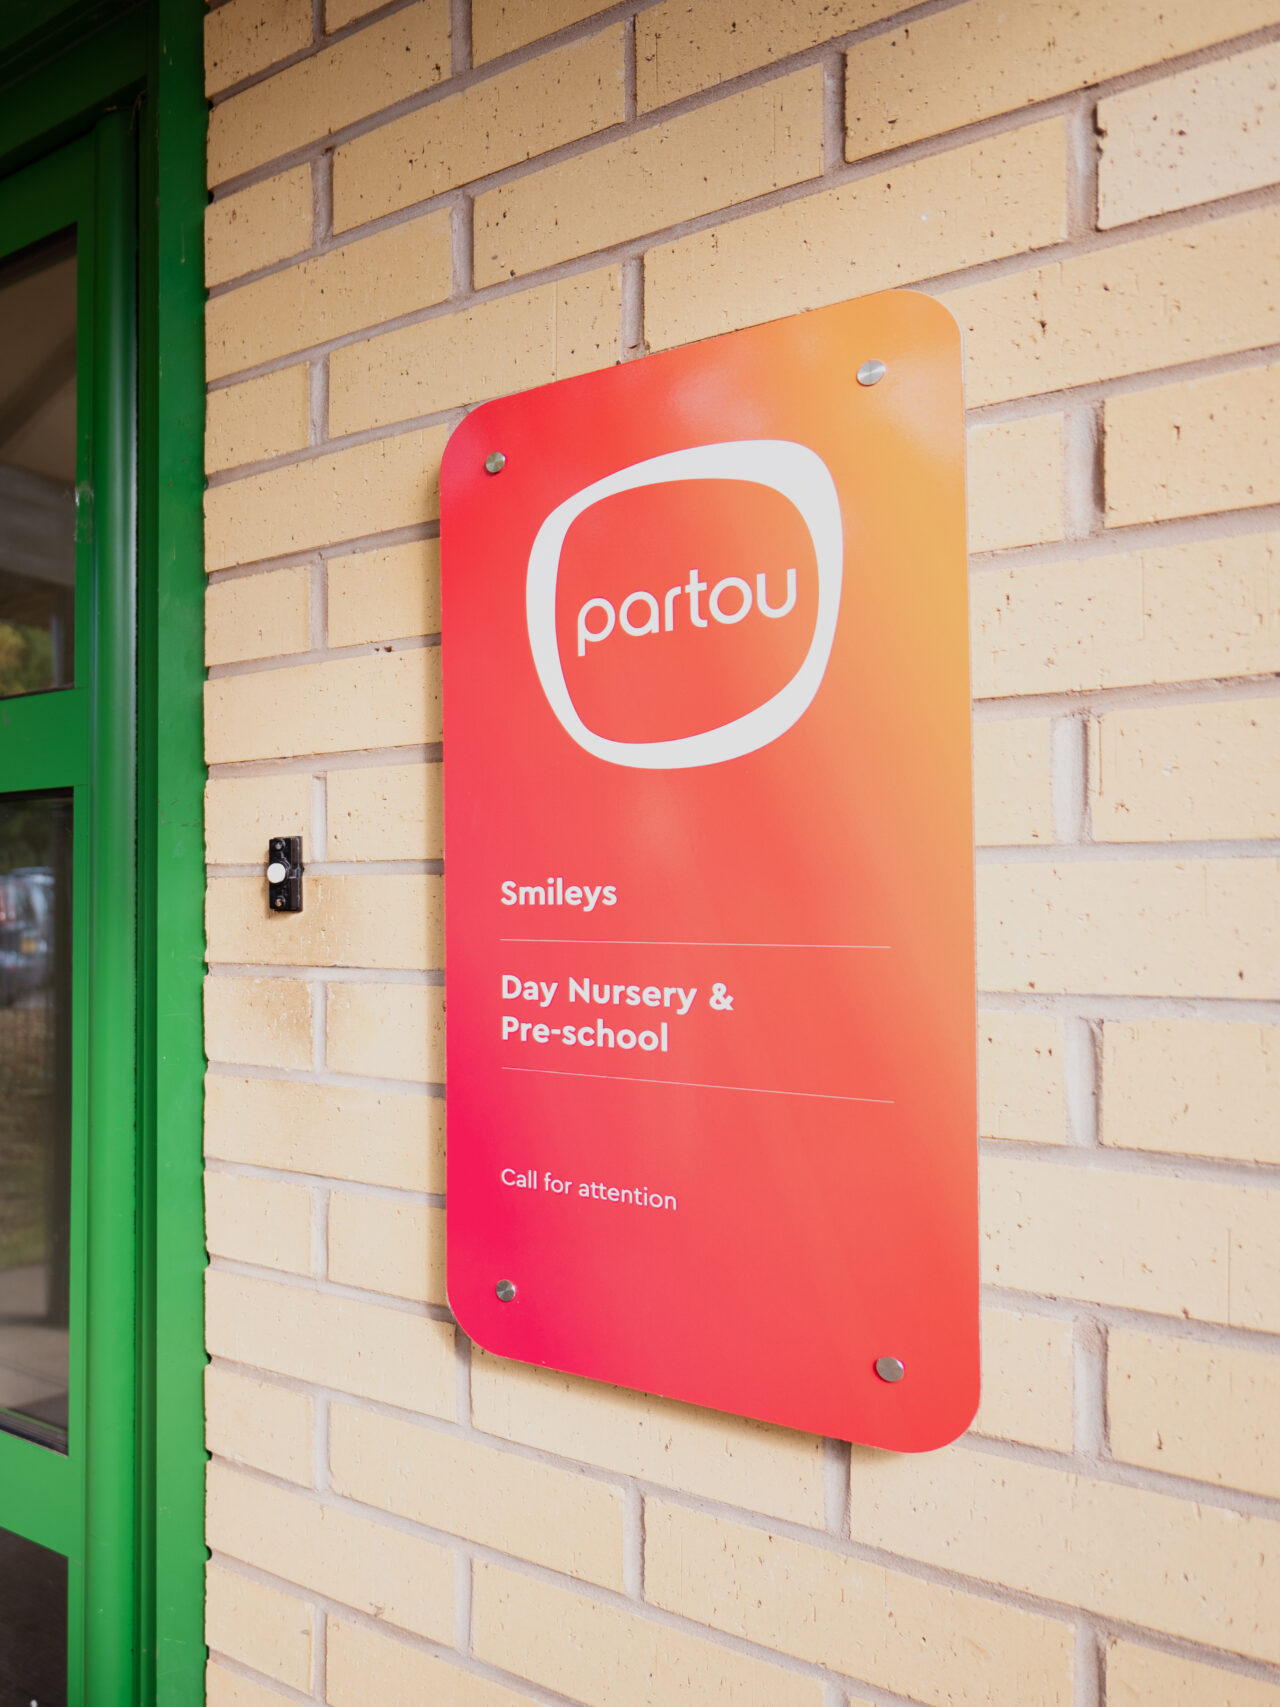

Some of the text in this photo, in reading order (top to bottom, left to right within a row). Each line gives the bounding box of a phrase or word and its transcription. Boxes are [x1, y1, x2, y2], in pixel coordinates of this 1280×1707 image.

[577, 567, 798, 657] partou
[500, 877, 618, 913] Smileys
[501, 974, 735, 1016] Day Nursery &
[502, 1015, 669, 1053] Pre-school
[500, 1168, 677, 1211] Call for attention
